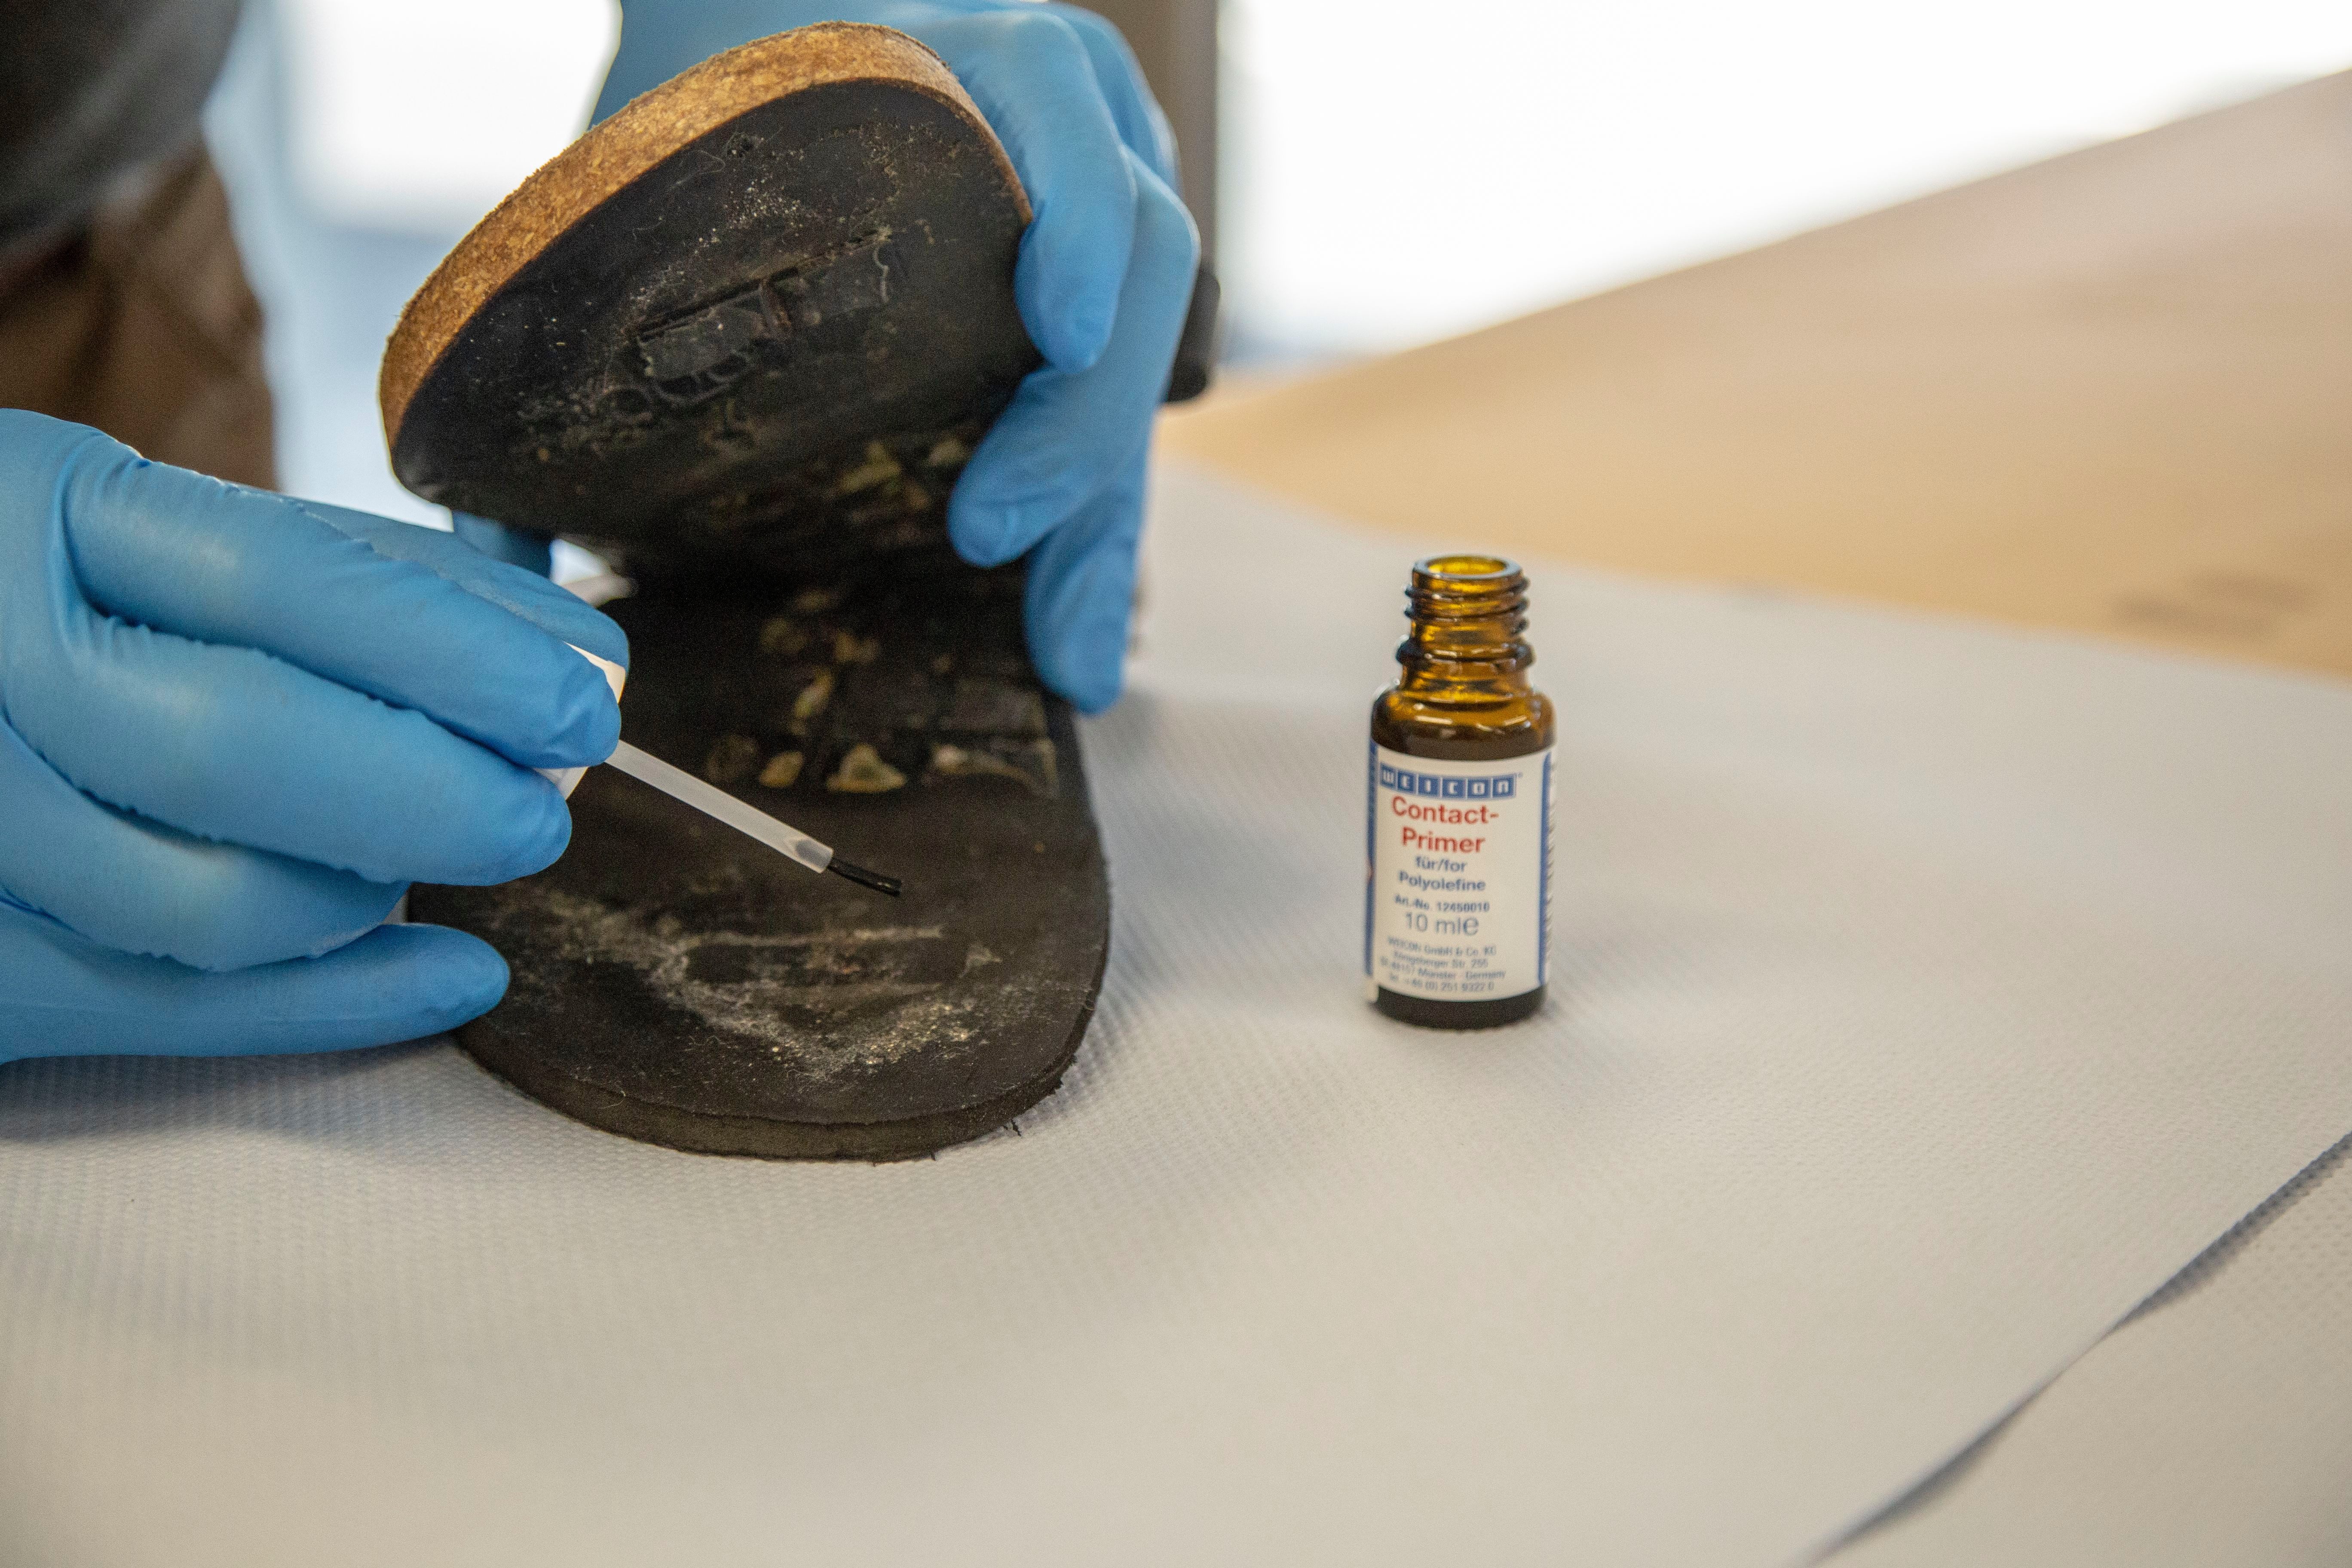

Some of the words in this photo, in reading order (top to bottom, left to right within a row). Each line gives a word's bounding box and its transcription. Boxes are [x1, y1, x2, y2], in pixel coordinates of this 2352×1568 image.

[1392, 796, 1499, 824] Contact-
[1402, 826, 1485, 853] Primer
[1415, 855, 1467, 872] für/for
[1399, 870, 1485, 891] Polyolefine
[1406, 912, 1428, 932] 10
